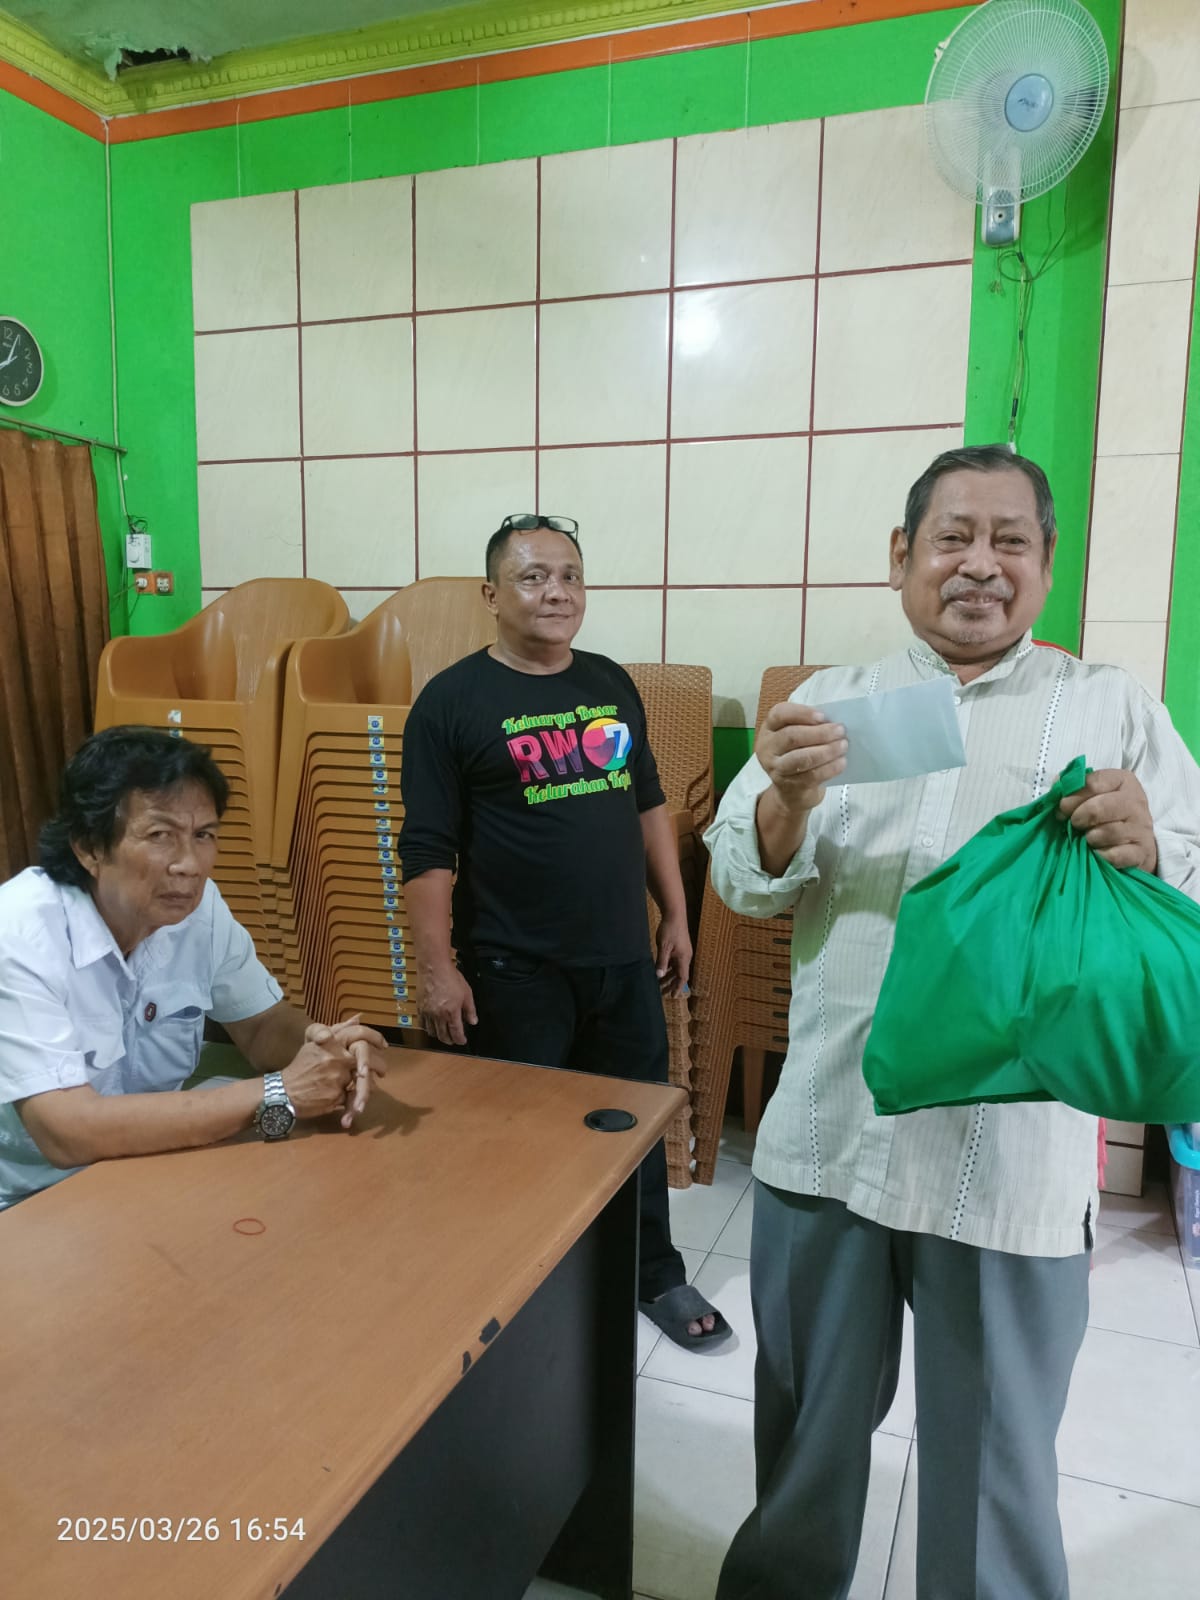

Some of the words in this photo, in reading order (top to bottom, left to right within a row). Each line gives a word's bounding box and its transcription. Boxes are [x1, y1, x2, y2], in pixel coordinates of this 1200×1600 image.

[3, 326, 13, 340] 12
[24, 347, 31, 360] 2
[26, 362, 33, 375] 3
[22, 377, 29, 389] 4
[2, 384, 10, 396] 6
[14, 384, 21, 396] 5
[501, 711, 576, 735] Keluarga
[575, 705, 618, 721] Besar
[524, 778, 609, 805] Kelurahan
